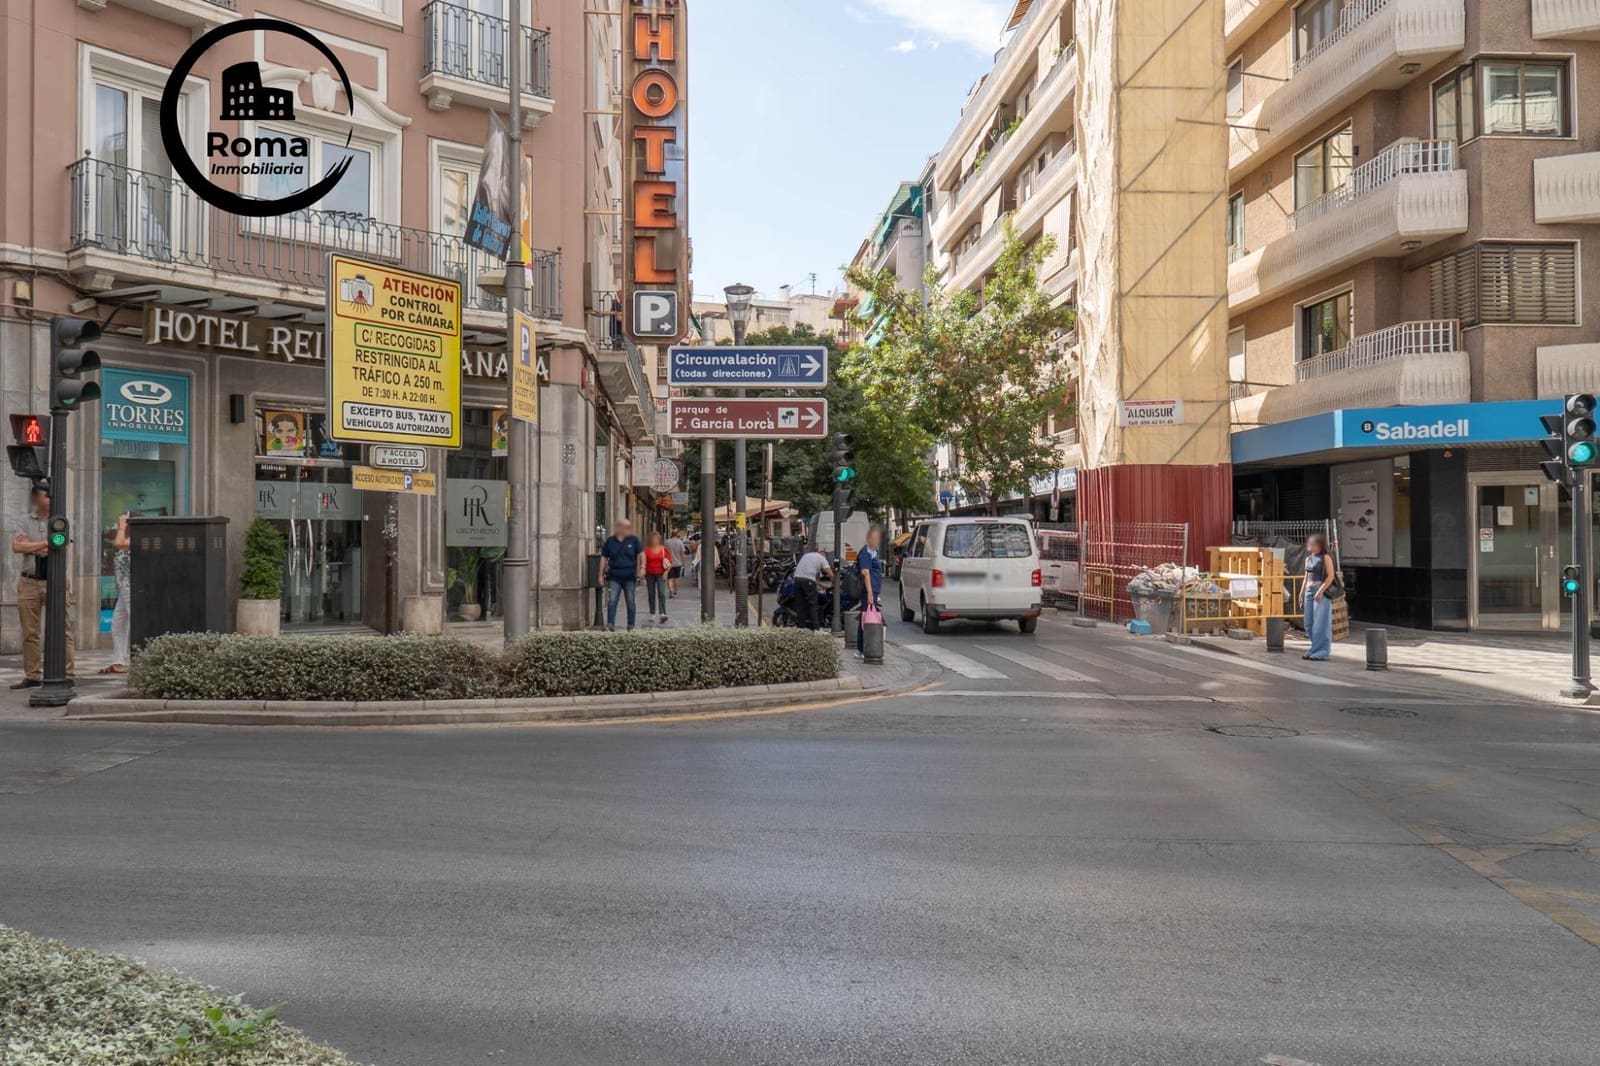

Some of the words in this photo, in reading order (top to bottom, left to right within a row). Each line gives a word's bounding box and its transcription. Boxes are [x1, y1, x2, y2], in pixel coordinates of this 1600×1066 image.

[632, 13, 679, 284] HOTEL
[383, 277, 454, 302] ATENCIÓN
[390, 295, 443, 314] CONTROL
[640, 295, 671, 332] P
[381, 308, 405, 321] POR
[408, 311, 454, 330] CÁMARA
[146, 308, 260, 351] HOTEL
[268, 326, 326, 362] REI
[362, 329, 372, 343] C/
[376, 330, 436, 353] RECOGIDAS
[355, 349, 425, 370] RESTRINGIDA
[428, 360, 441, 373] AL
[675, 353, 776, 365] Circunvalación
[352, 366, 400, 385] TRÁFICO
[403, 374, 411, 387] A
[414, 375, 430, 389] 250
[433, 380, 444, 391] m.
[675, 369, 707, 378] (todas
[713, 369, 772, 378] direcciones)
[362, 386, 373, 397] DE
[375, 387, 391, 399] 7:30
[393, 390, 400, 400] H.
[402, 392, 408, 401] A
[409, 392, 428, 403] 22:00
[429, 395, 437, 404] H.
[106, 403, 184, 426] TORRES
[350, 406, 393, 418] EXCEPTO
[395, 411, 416, 422] BUS,
[418, 413, 438, 422] TAXI
[440, 415, 446, 423] Y
[675, 406, 709, 415] parque
[107, 421, 183, 432] INMOBILIARIA
[346, 418, 394, 430] VEHÍCULOS
[396, 424, 450, 434] AUTORIZADOS
[675, 418, 687, 429] F.
[691, 417, 734, 429] García
[738, 418, 775, 429] Lorca
[1375, 419, 1469, 440] Sabadell
